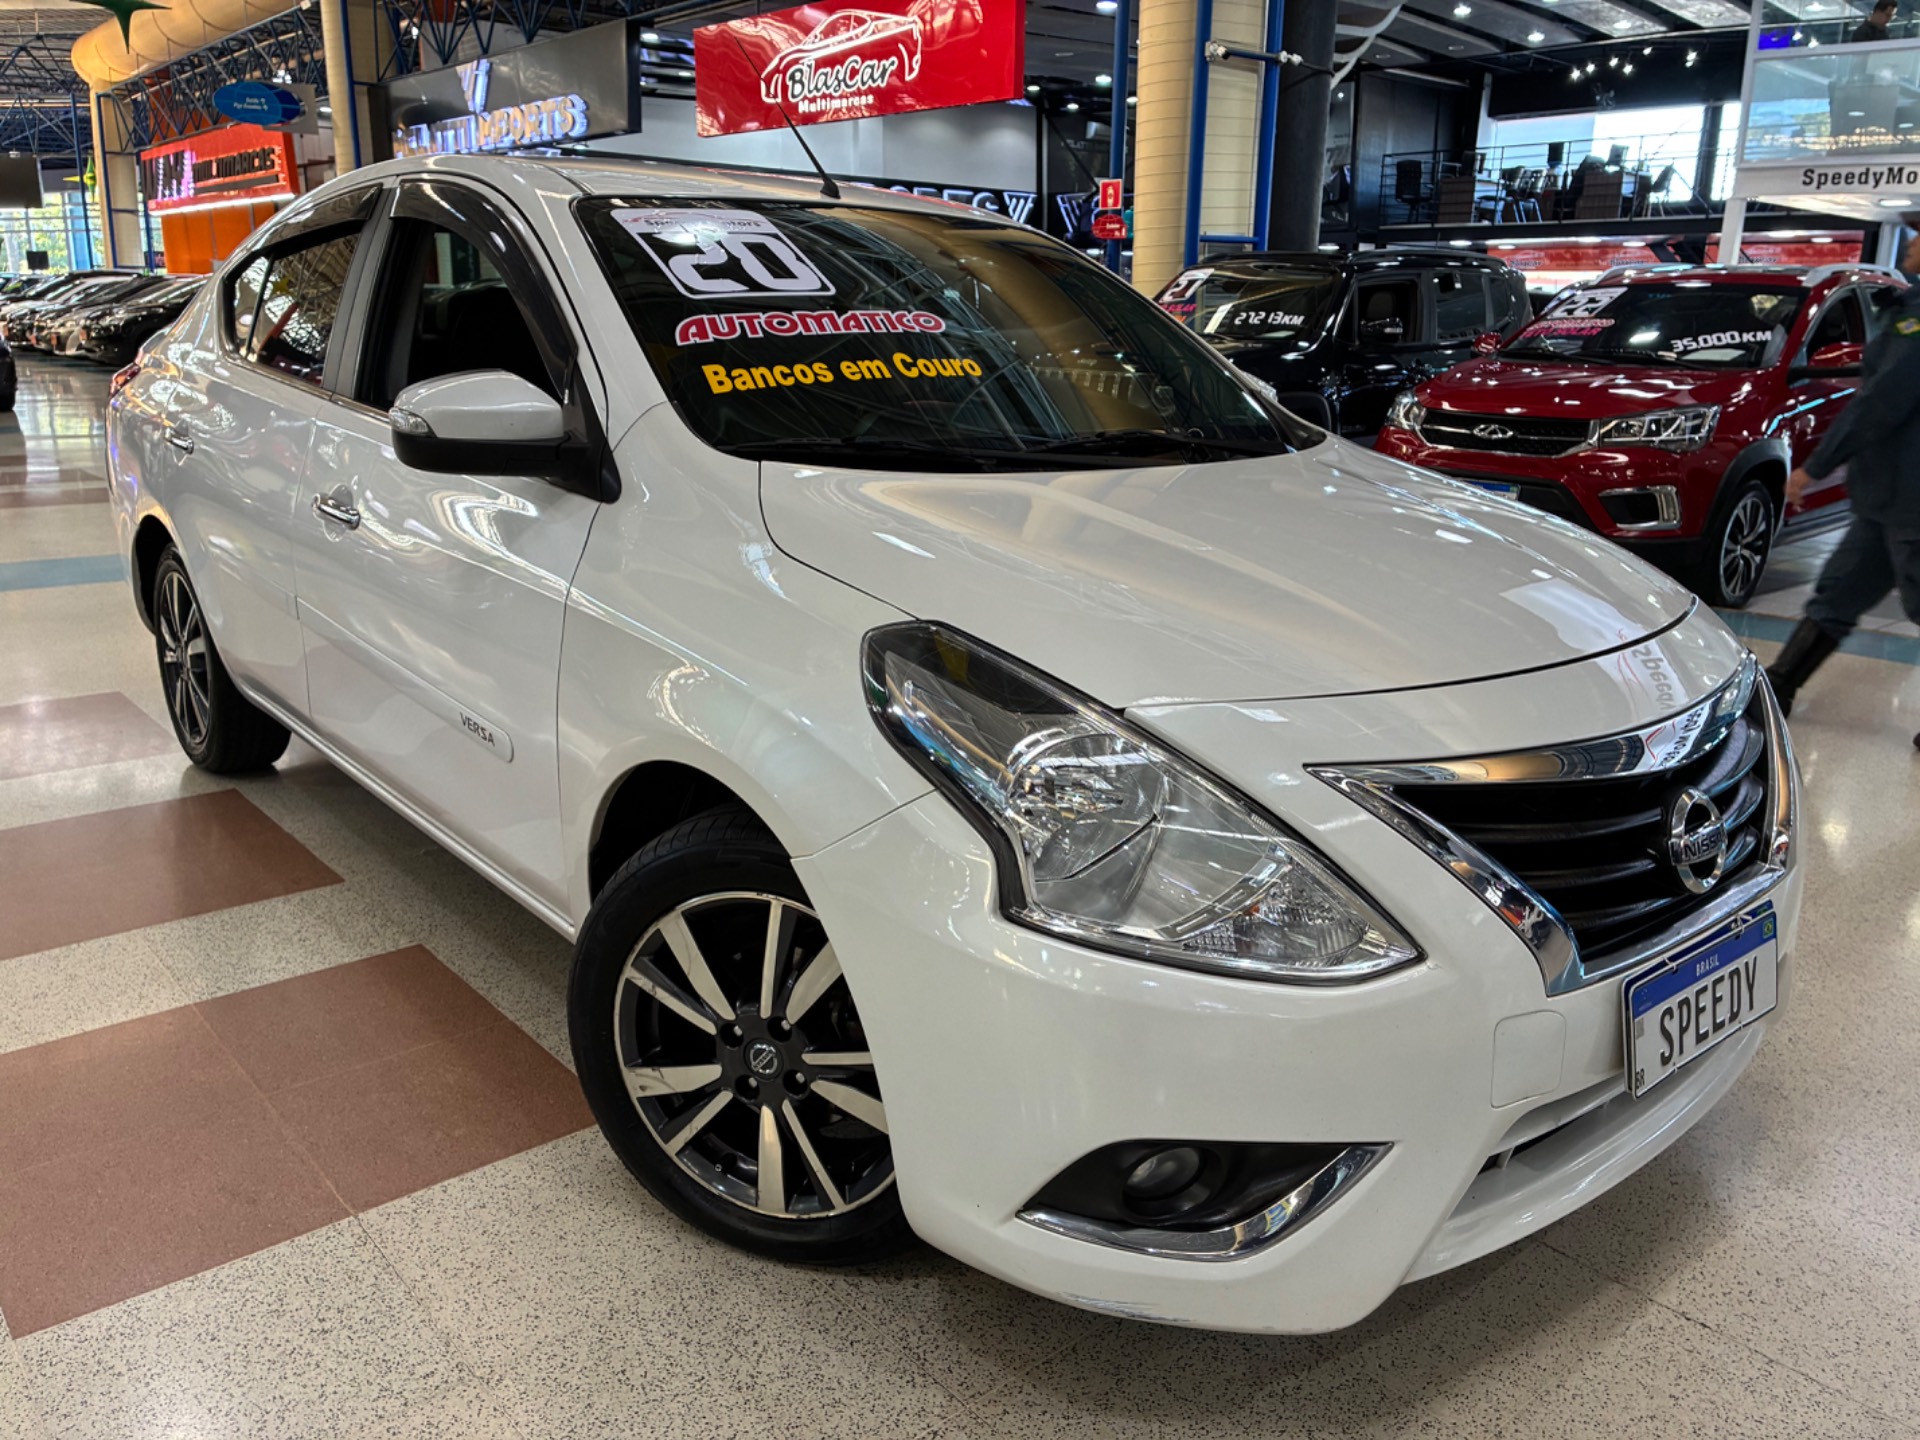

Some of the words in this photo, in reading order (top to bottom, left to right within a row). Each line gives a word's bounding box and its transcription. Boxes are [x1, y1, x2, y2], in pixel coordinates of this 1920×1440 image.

[786, 55, 898, 102] BlasCar
[798, 94, 874, 114] Multimarcas
[1802, 167, 1919, 189] SpeedyMo
[653, 233, 823, 293] 20
[675, 309, 946, 346] AUTOMATICO
[701, 363, 834, 395] Bancos
[840, 358, 891, 381] em
[892, 351, 983, 378] Couro
[459, 711, 495, 748] VERSA
[1696, 954, 1720, 977] BRASIL
[1659, 955, 1758, 1067] SPEEDY
